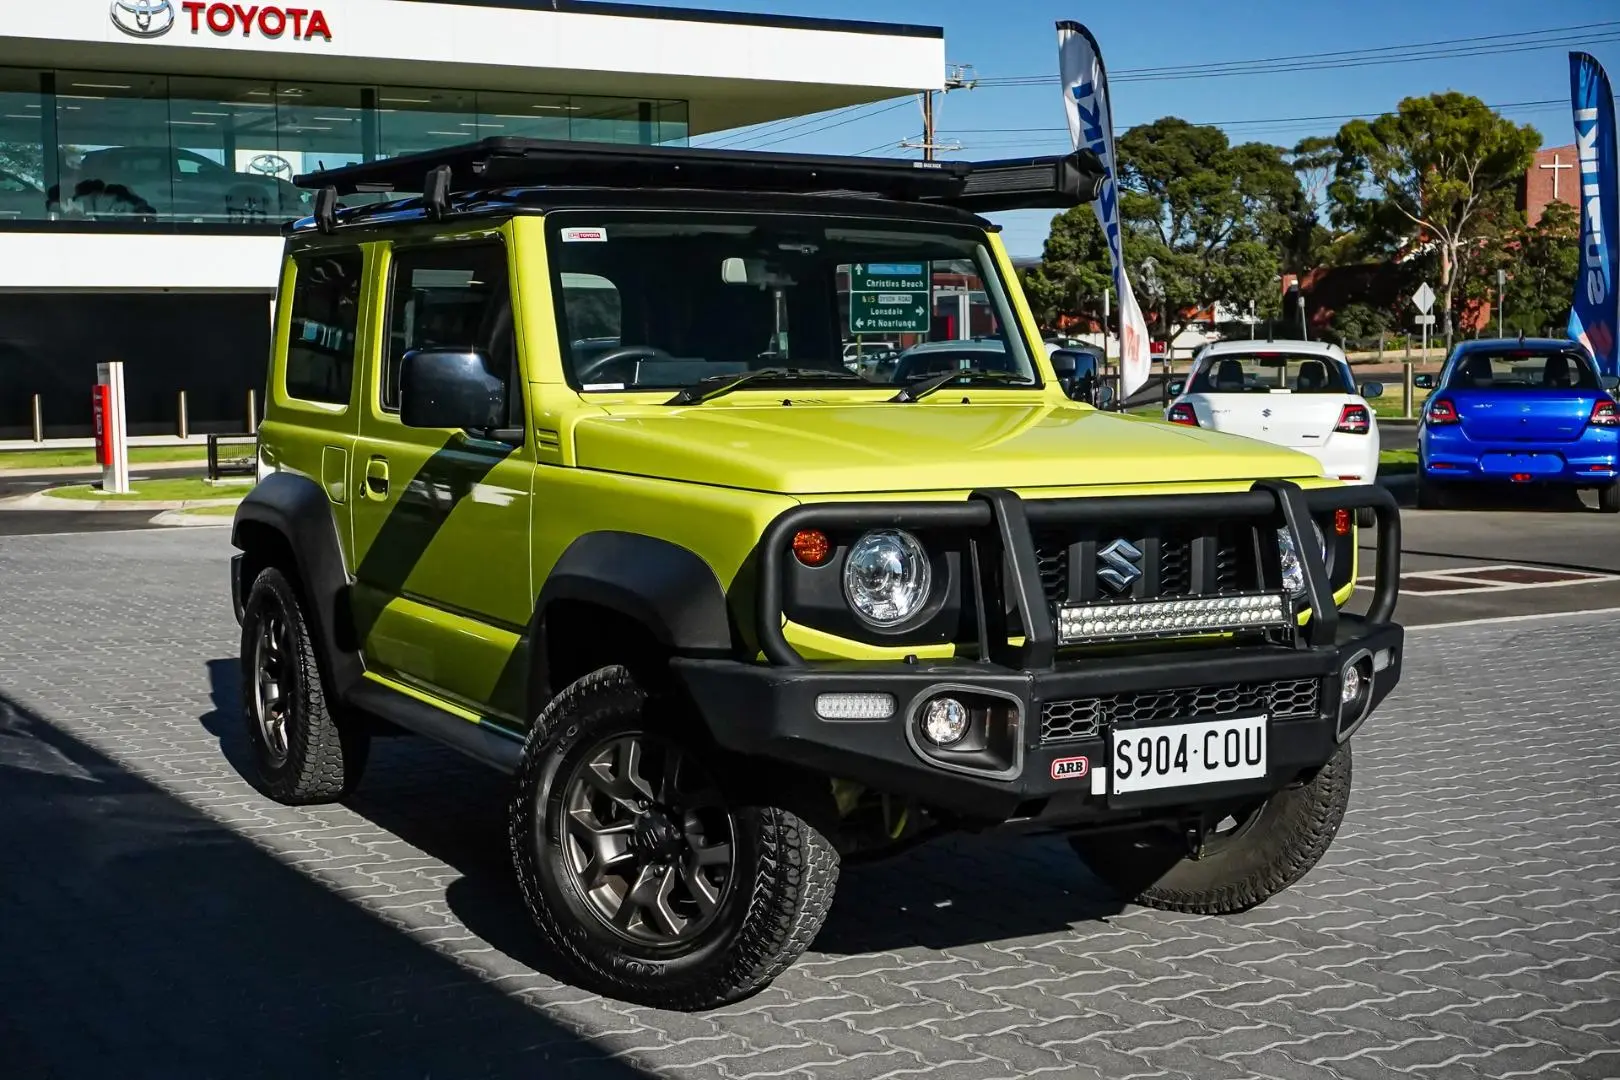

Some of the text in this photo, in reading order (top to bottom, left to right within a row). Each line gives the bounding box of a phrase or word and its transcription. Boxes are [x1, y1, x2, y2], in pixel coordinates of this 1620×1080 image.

[182, 1, 332, 41] TOYOTA
[866, 279, 924, 288] Christies Beach
[870, 307, 903, 316] Lonsdale
[867, 319, 917, 329] Pt Noarlunga
[1057, 761, 1083, 775] ARB
